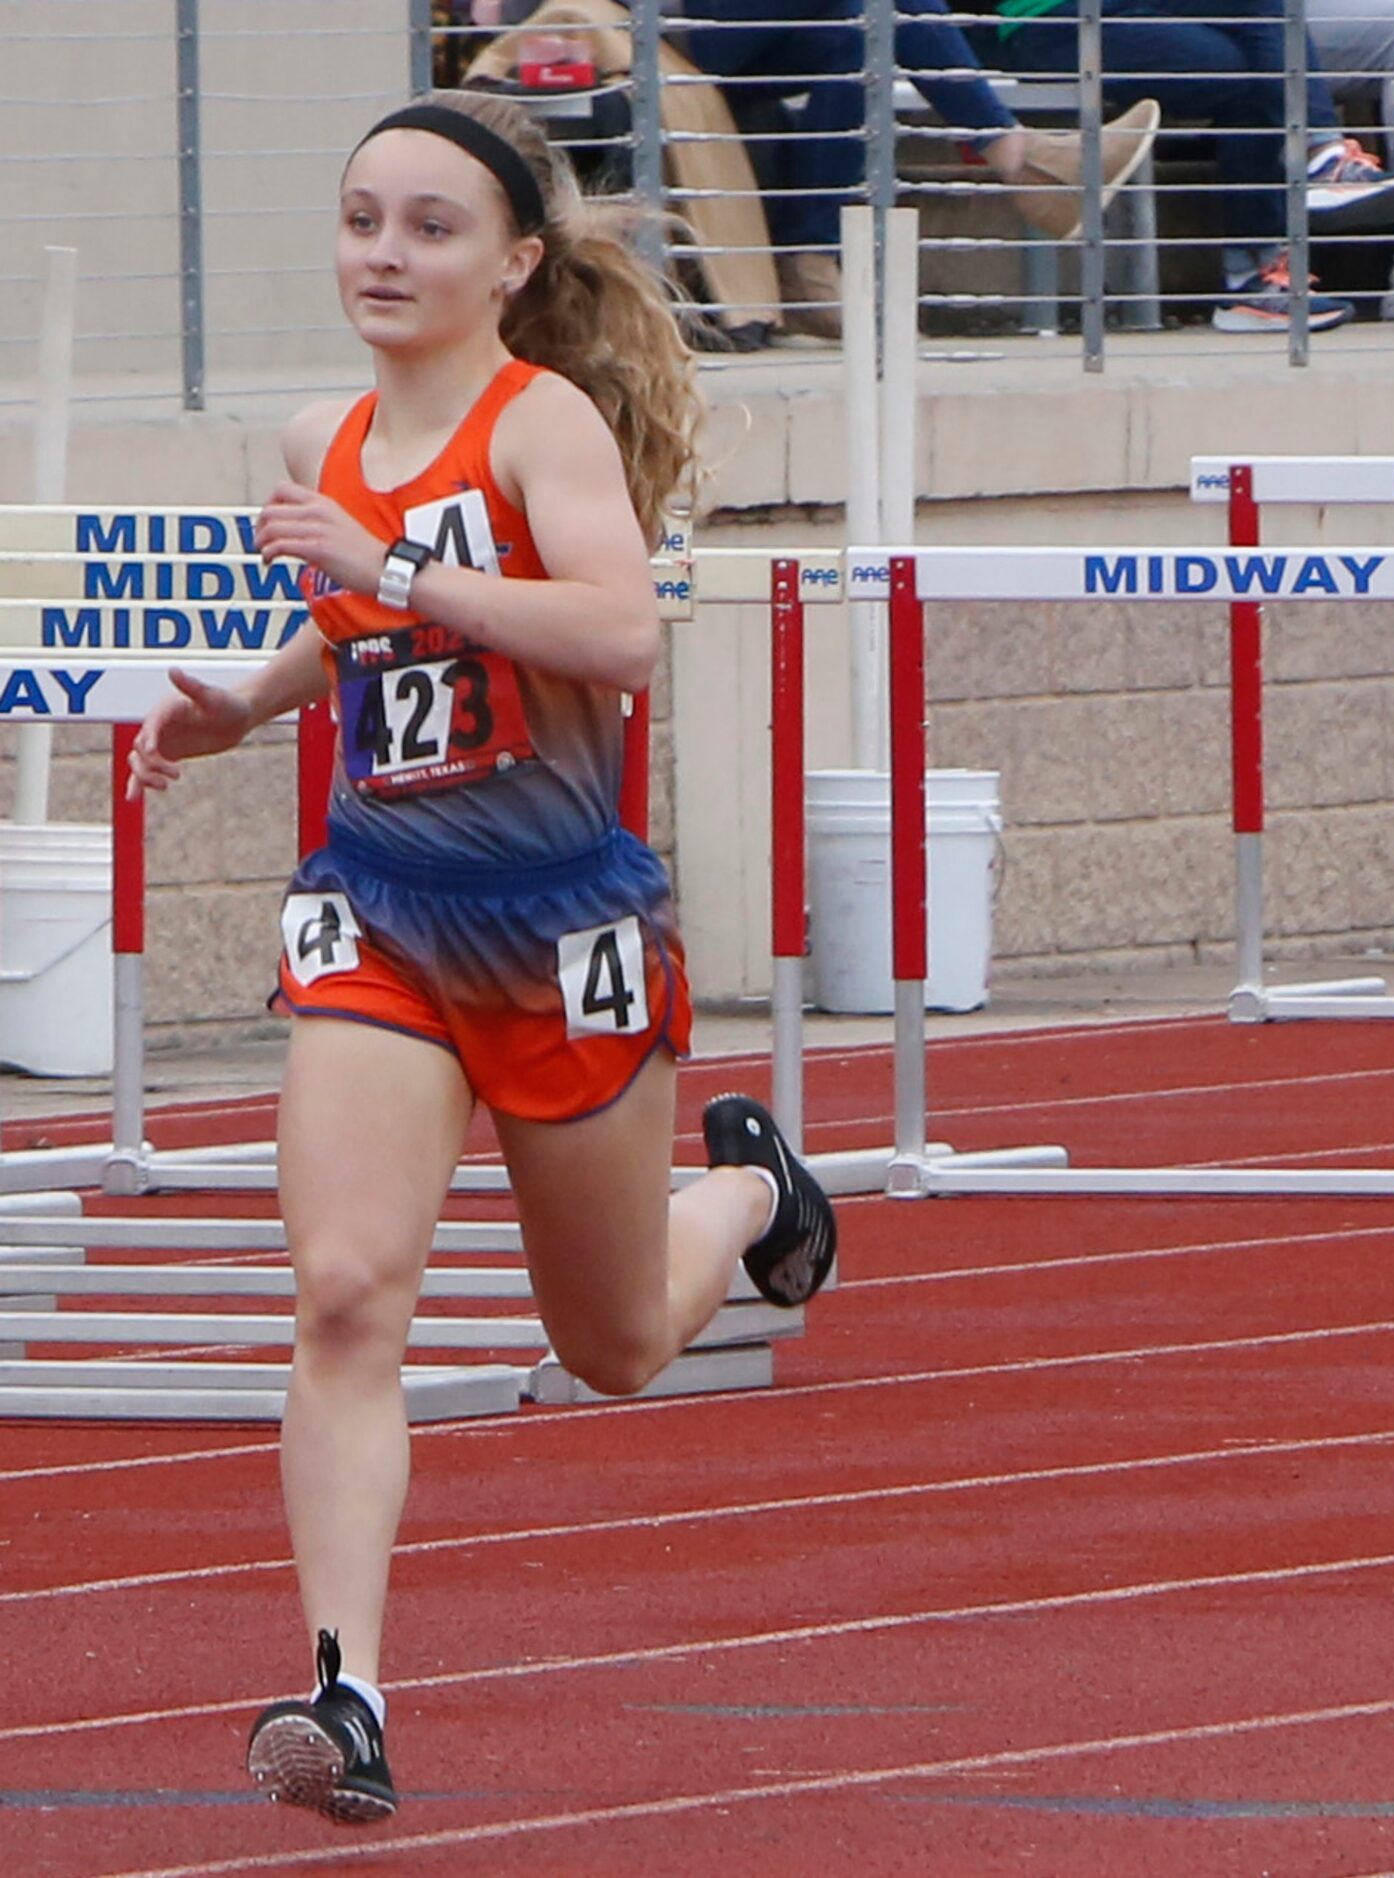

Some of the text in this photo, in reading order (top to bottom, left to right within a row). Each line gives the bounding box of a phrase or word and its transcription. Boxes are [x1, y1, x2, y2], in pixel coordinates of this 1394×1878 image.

[1083, 553, 1388, 595] MIDWAY
[0, 669, 105, 714] AY
[356, 660, 494, 768] 423
[430, 761, 466, 778] TEXAS
[298, 902, 341, 964] 4
[582, 930, 634, 1028] 4
